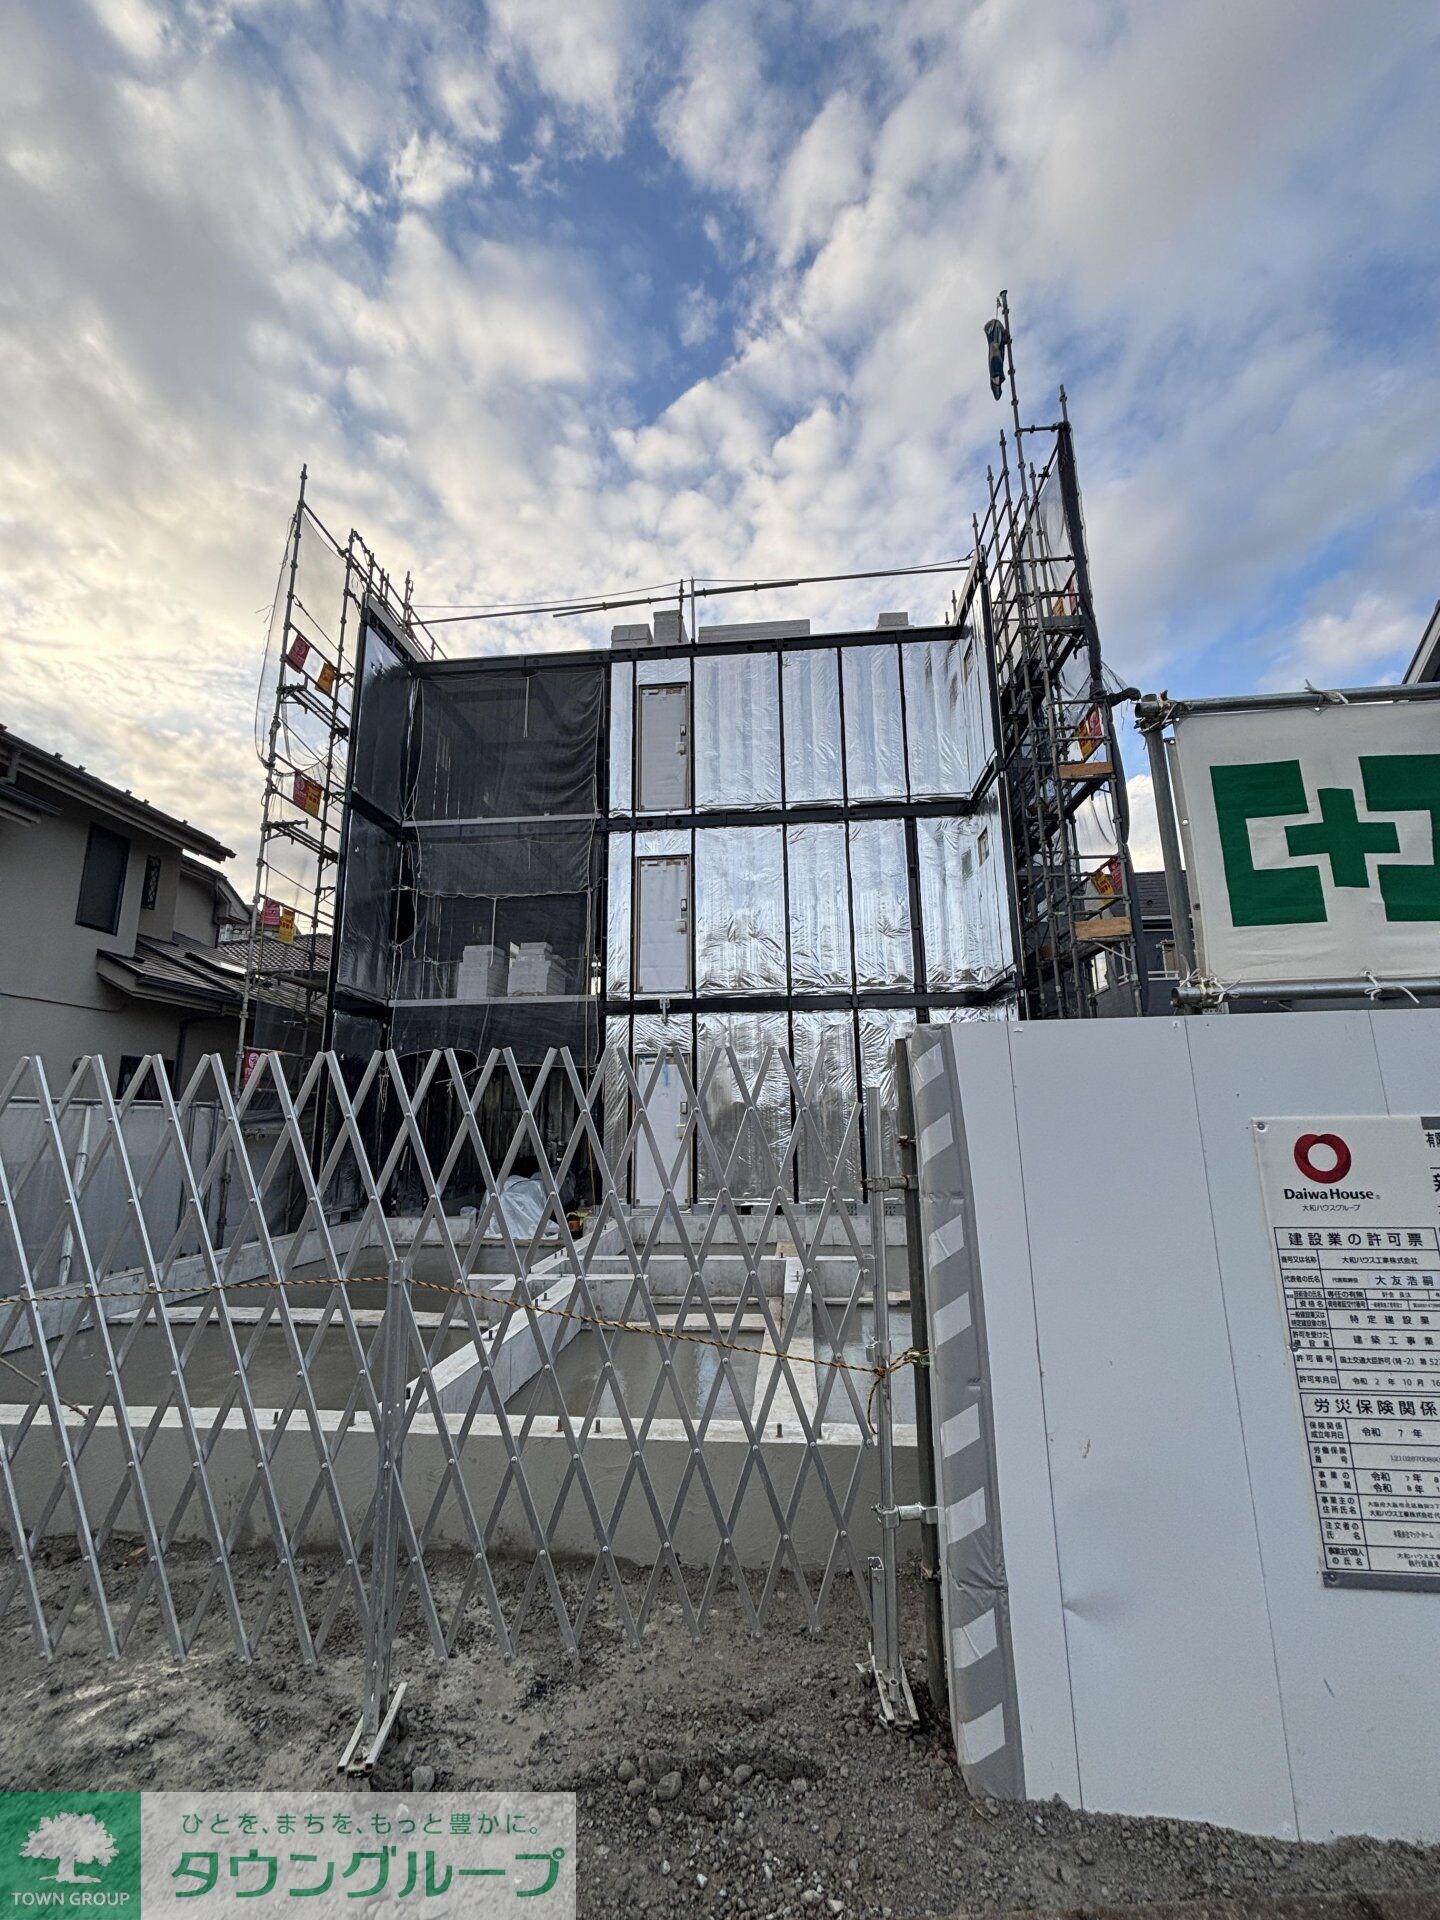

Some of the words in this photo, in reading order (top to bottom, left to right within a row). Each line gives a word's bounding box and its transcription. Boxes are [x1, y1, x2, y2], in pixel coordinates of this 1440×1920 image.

[1284, 1188, 1328, 1200] Daiwa
[1329, 1188, 1374, 1200] House
[1302, 1203, 1361, 1212] 大和ハウスグループ
[1288, 1232, 1424, 1247] 建設業の許可票
[1341, 1256, 1418, 1265] 大和ハウス工業株式会社
[1299, 1375, 1338, 1385] 許可年月日
[1314, 1398, 1438, 1417] 労災保険関係
